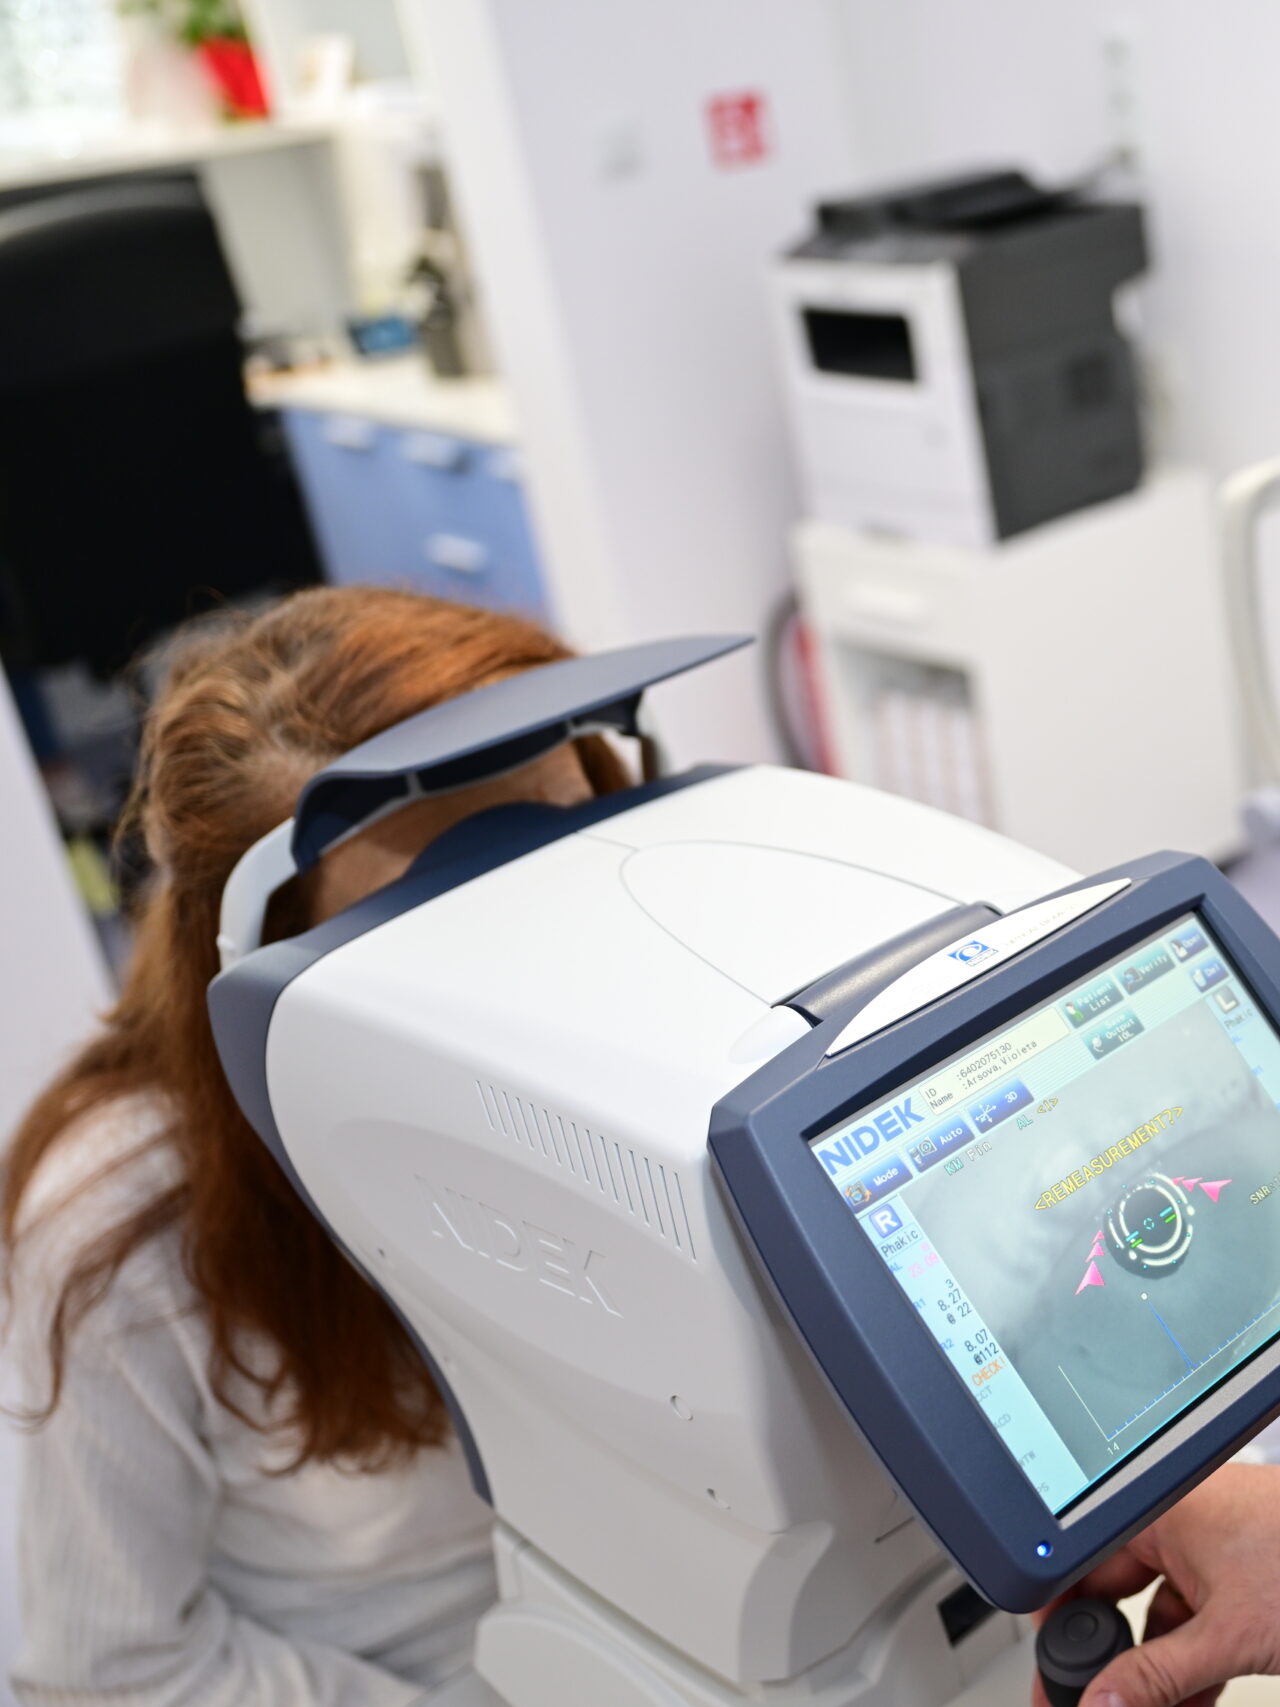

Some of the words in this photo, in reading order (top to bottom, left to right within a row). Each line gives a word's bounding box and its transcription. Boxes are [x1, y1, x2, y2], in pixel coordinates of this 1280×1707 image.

[1138, 954, 1169, 976] Verify
[1076, 983, 1112, 1007] Patient
[1089, 996, 1111, 1012] List
[1214, 991, 1238, 1012] L
[1105, 1018, 1135, 1040] Output
[1117, 1030, 1134, 1042] IOL
[925, 1087, 937, 1099] ID
[929, 1091, 954, 1110] Name
[1004, 1090, 1019, 1104] 3D
[818, 1096, 926, 1176] NIDEK
[939, 1126, 963, 1146] Auto
[943, 1158, 965, 1176] KM
[966, 1141, 993, 1161] Fin
[1015, 1115, 1034, 1130] AL
[1033, 1105, 1184, 1211] <REMEASUREMENT?>
[872, 1167, 899, 1187] Mode
[874, 1210, 898, 1234] R
[413, 1173, 625, 1319] NIDEK
[880, 1229, 919, 1258] Phakic
[945, 1278, 954, 1289] 3
[937, 1287, 962, 1312] 8.27
[957, 1301, 973, 1318] 22
[964, 1328, 989, 1353] 8.07
[971, 1356, 1007, 1387] CHECK!
[1106, 1441, 1121, 1456] 14
